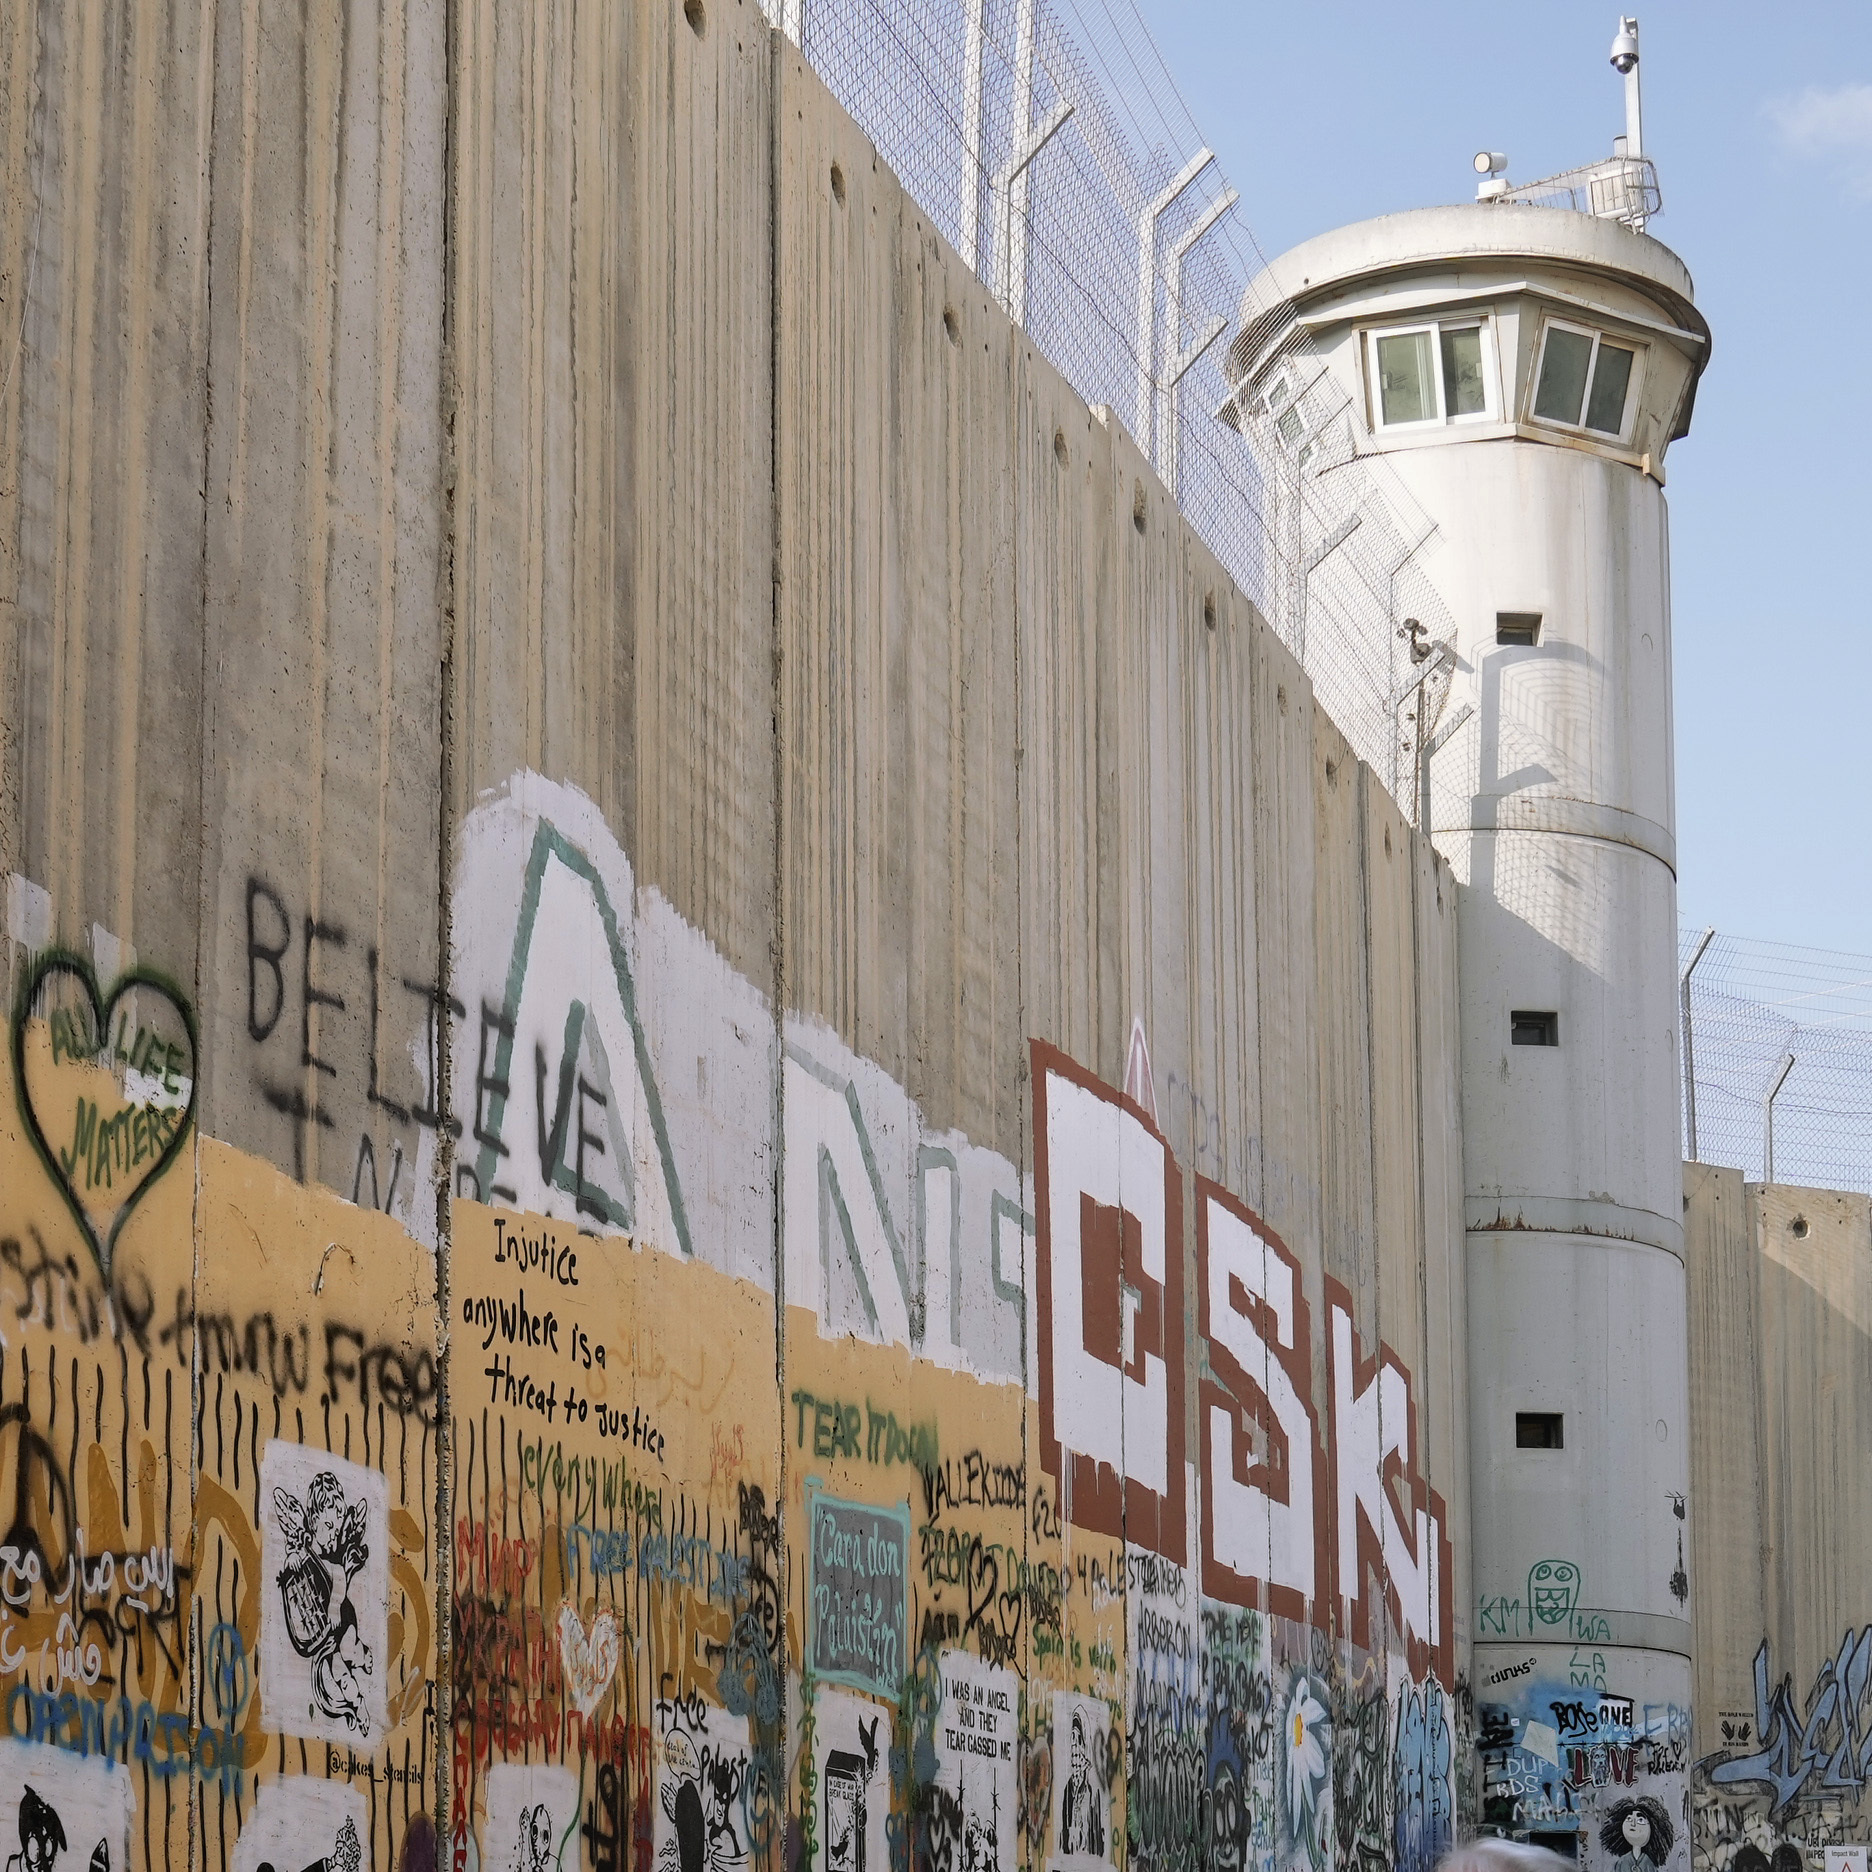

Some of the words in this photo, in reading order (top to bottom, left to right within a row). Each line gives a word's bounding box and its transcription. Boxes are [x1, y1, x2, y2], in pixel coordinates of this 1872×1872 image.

[115, 1011, 185, 1095] LIFE
[62, 1096, 177, 1189] MATTERS
[463, 1288, 559, 1354] anywhere
[485, 1354, 558, 1423] threat
[564, 1388, 588, 1423] to
[792, 1389, 861, 1458] TEAR
[951, 1682, 971, 1703] WAS
[973, 1687, 984, 1705] AN
[987, 1689, 1011, 1713] ANGEL
[959, 1708, 975, 1728] AND
[978, 1710, 998, 1733] THEY
[945, 1729, 966, 1751] TEAR
[968, 1735, 998, 1758] GASSED
[1000, 1741, 1012, 1761] ME
